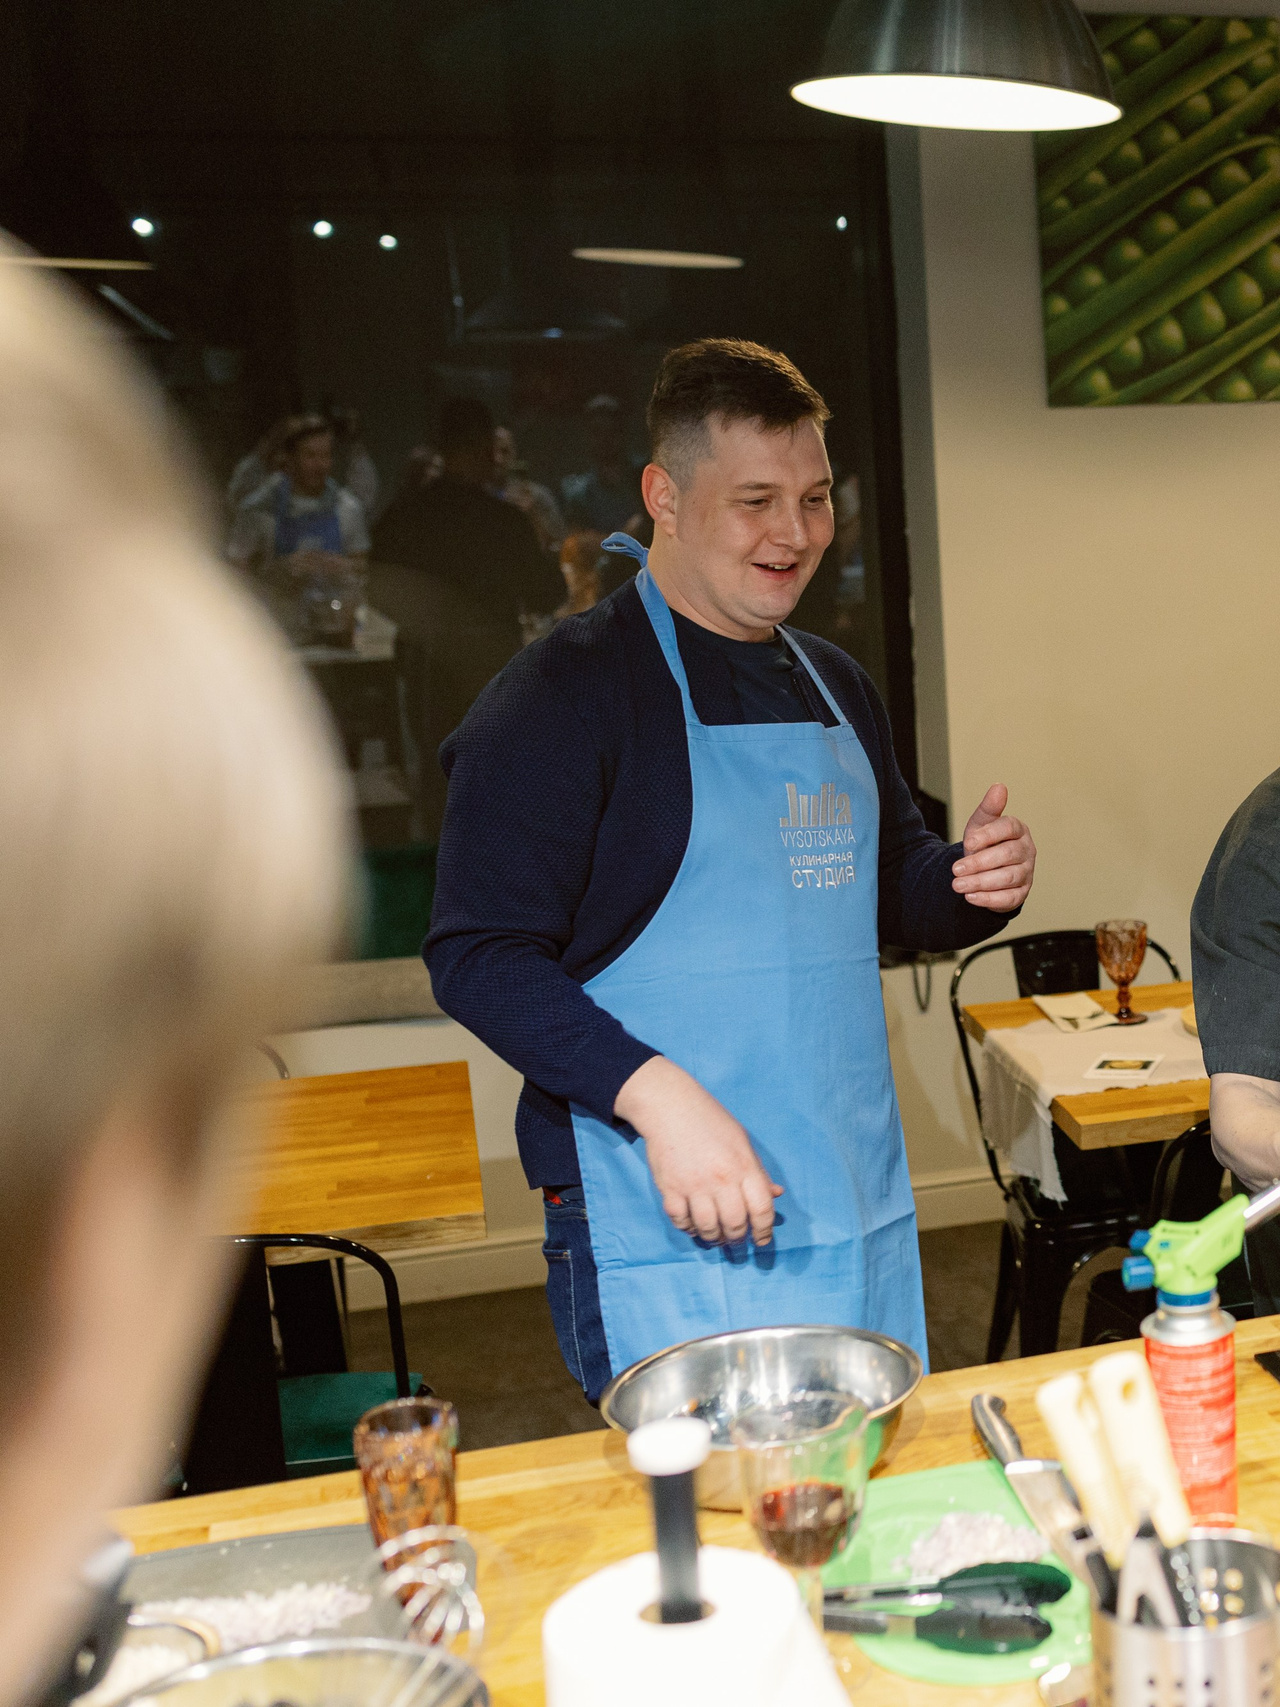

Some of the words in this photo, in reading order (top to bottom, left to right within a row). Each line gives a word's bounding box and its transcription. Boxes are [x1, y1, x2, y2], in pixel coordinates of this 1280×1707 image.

[779, 783, 853, 827] Julia
[780, 828, 857, 848] VYSOTSKAYA
[789, 851, 854, 867] КУЛИНАРНАЯ
[791, 865, 857, 890] СТУДИЯ
